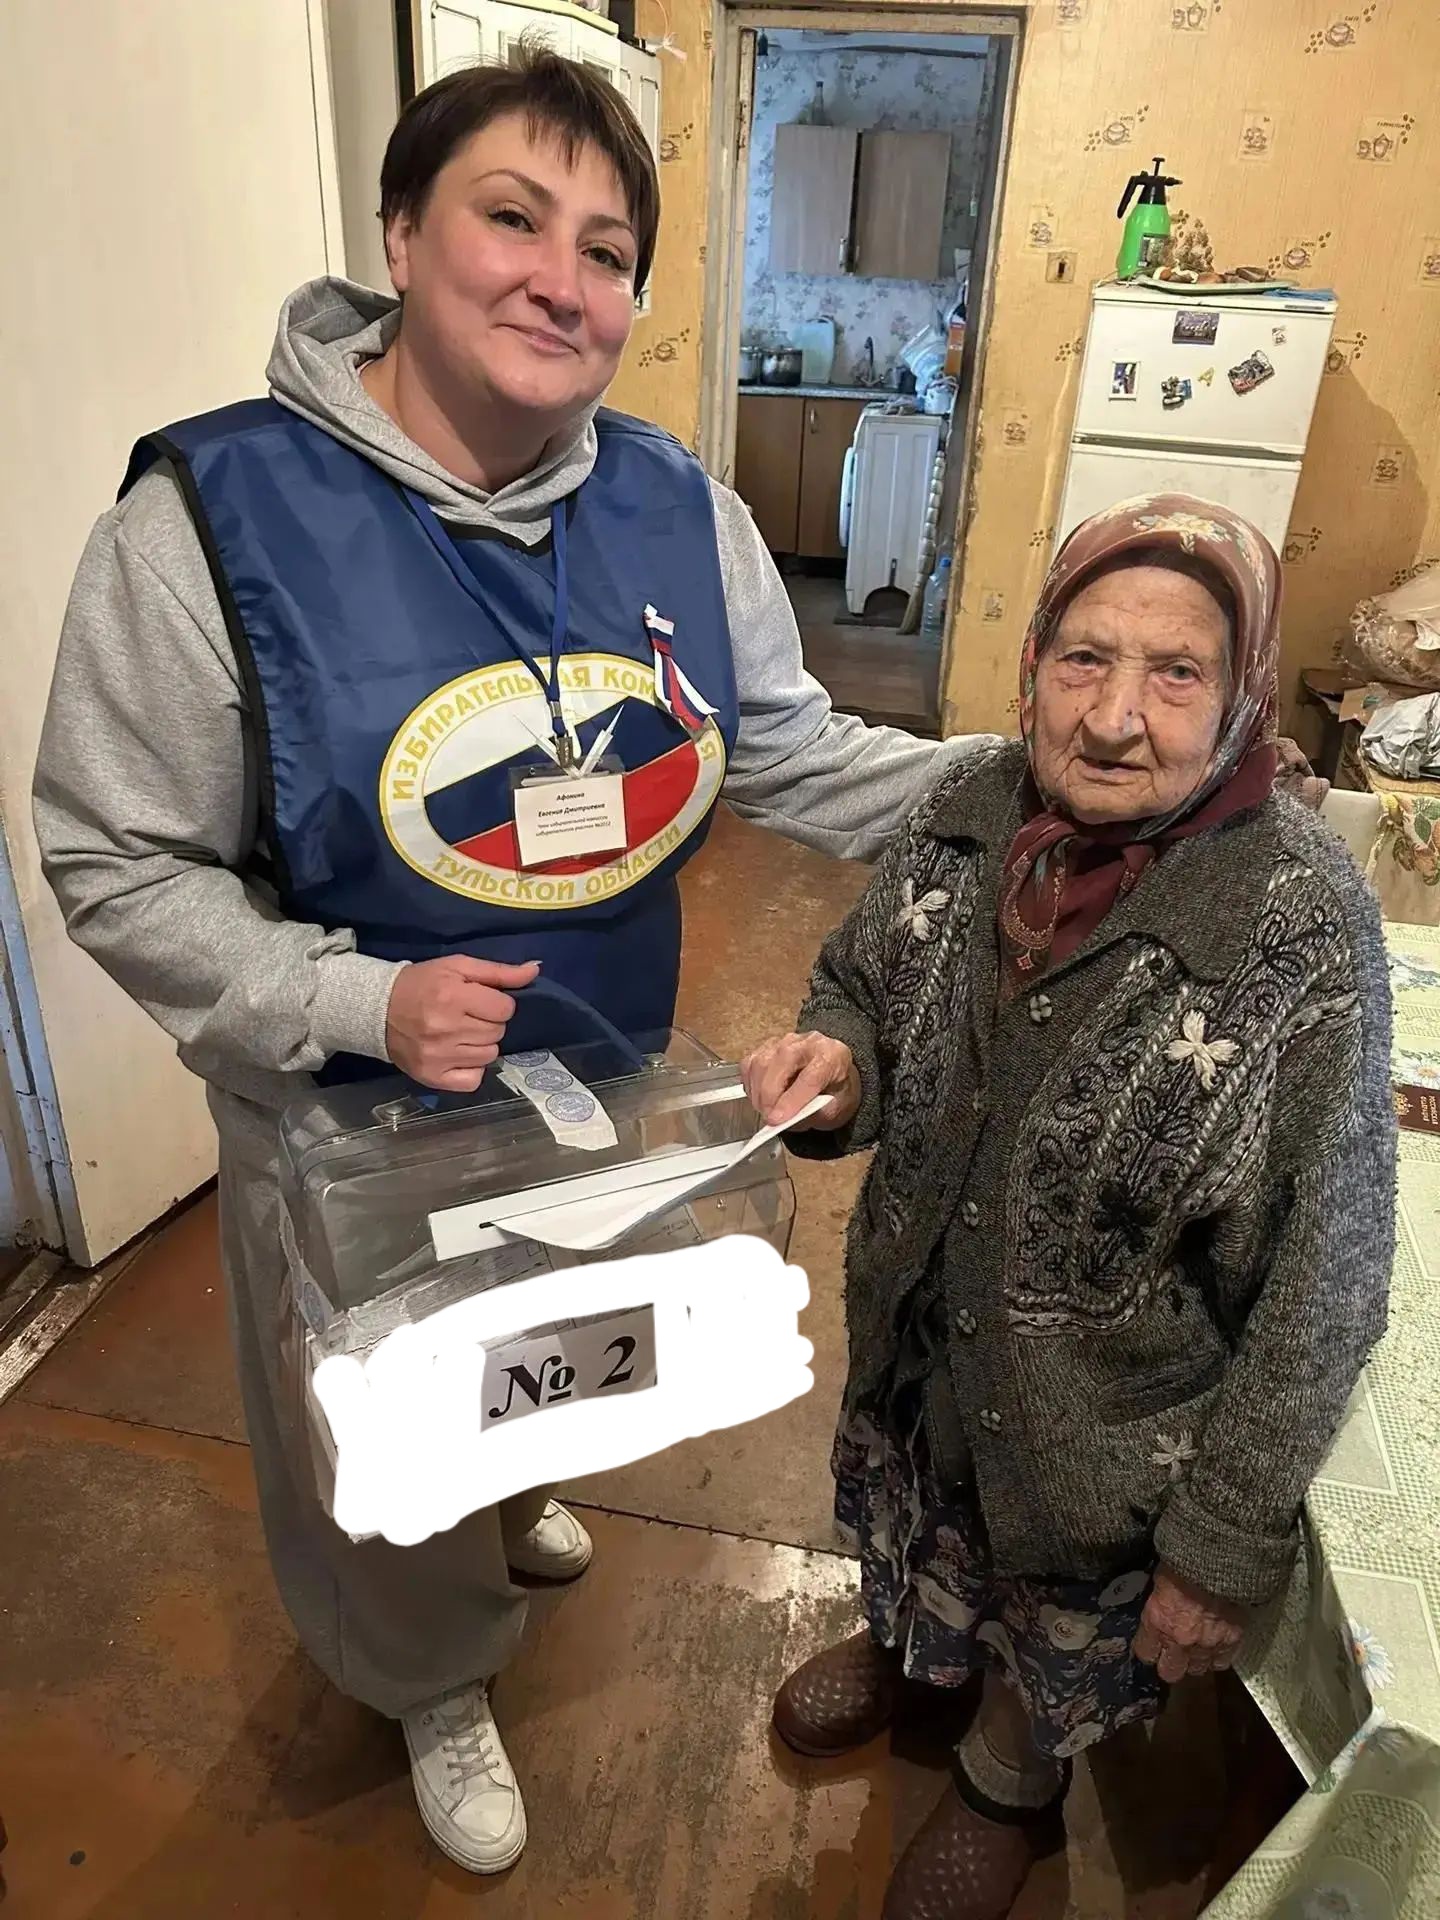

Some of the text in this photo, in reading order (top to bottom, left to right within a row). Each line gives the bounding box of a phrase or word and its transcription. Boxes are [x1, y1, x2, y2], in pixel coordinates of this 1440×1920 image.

[393, 666, 591, 800] ИЗБИРАТЕЛЬАЯ
[538, 803, 605, 817] Евгения Дмитриевна
[433, 823, 682, 900] ТУЛЬСКОЙ ОБЛАСТИ
[489, 1336, 637, 1418] № 2
